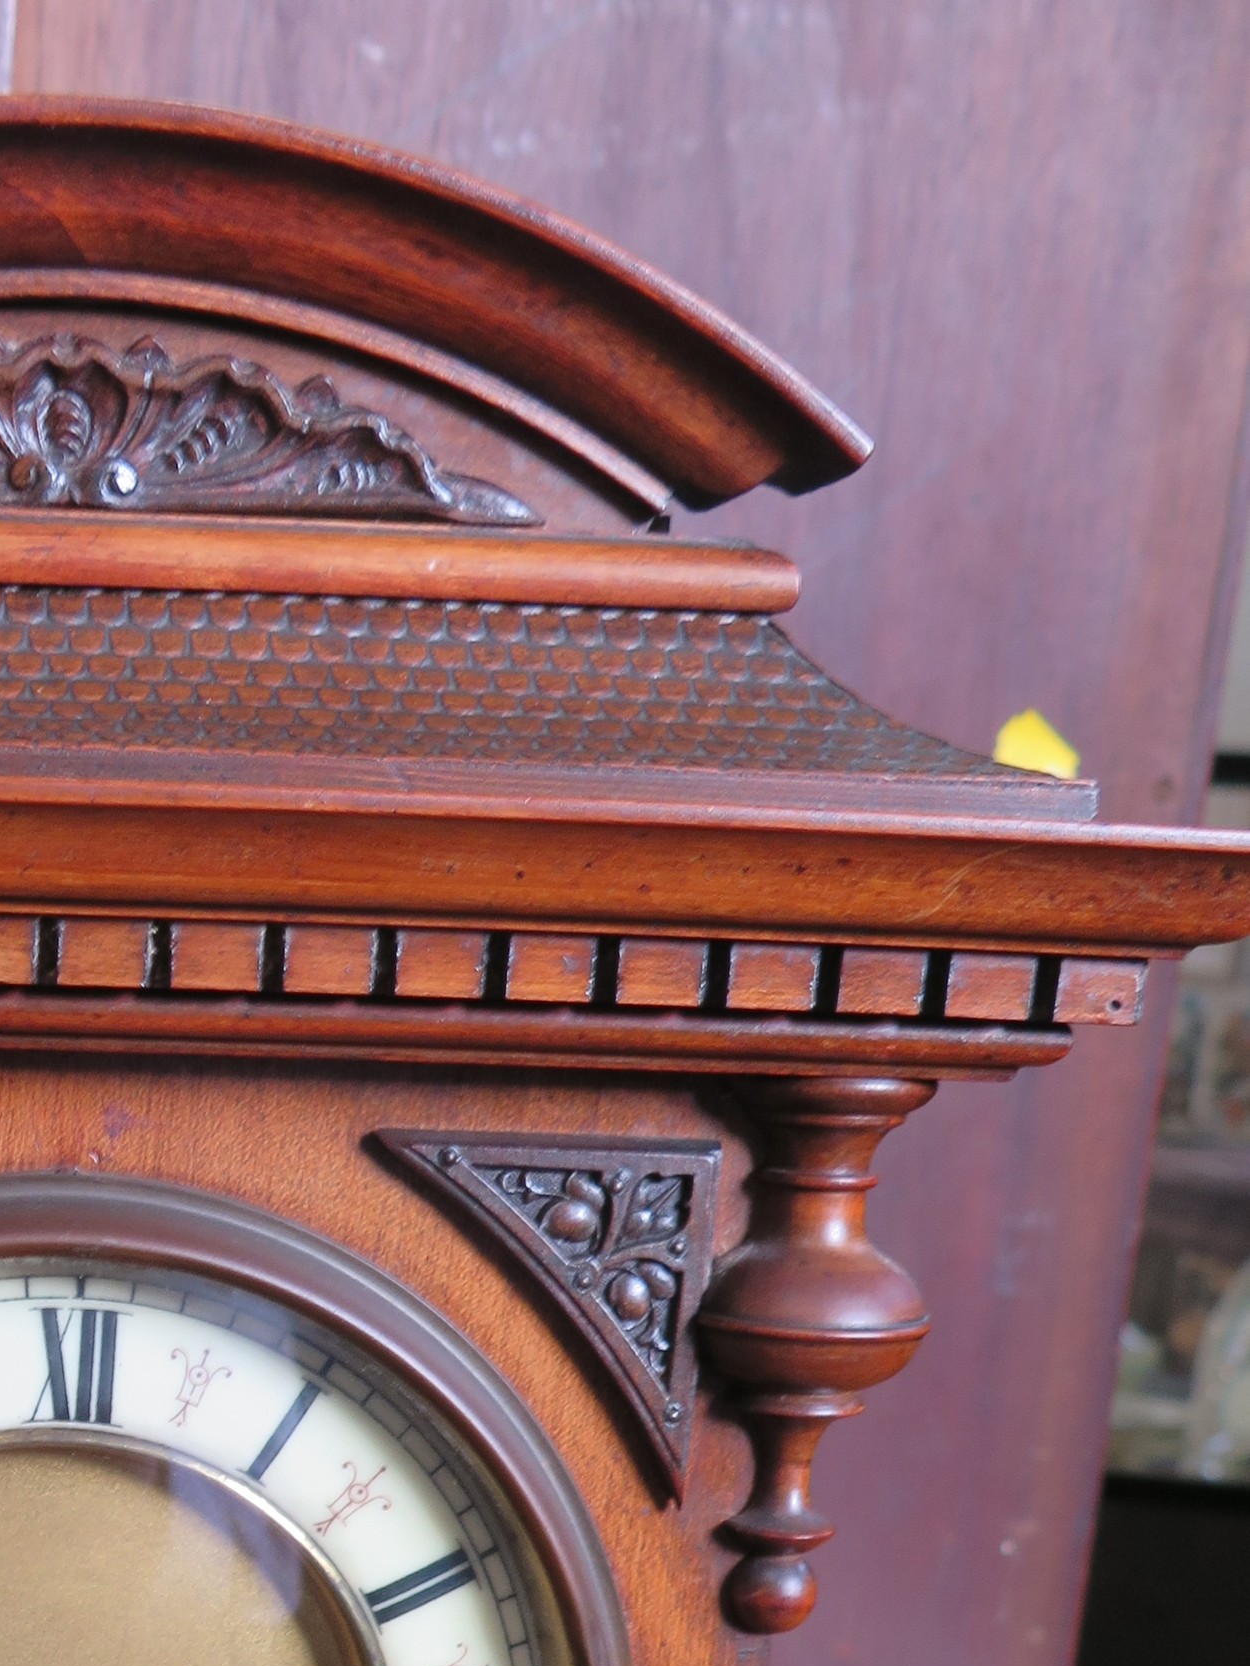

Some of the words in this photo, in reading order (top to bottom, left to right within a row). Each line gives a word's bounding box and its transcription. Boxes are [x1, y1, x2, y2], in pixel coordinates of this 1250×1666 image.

[22, 1307, 133, 1429] XII
[236, 1374, 330, 1486] I
[359, 1538, 484, 1635] II
